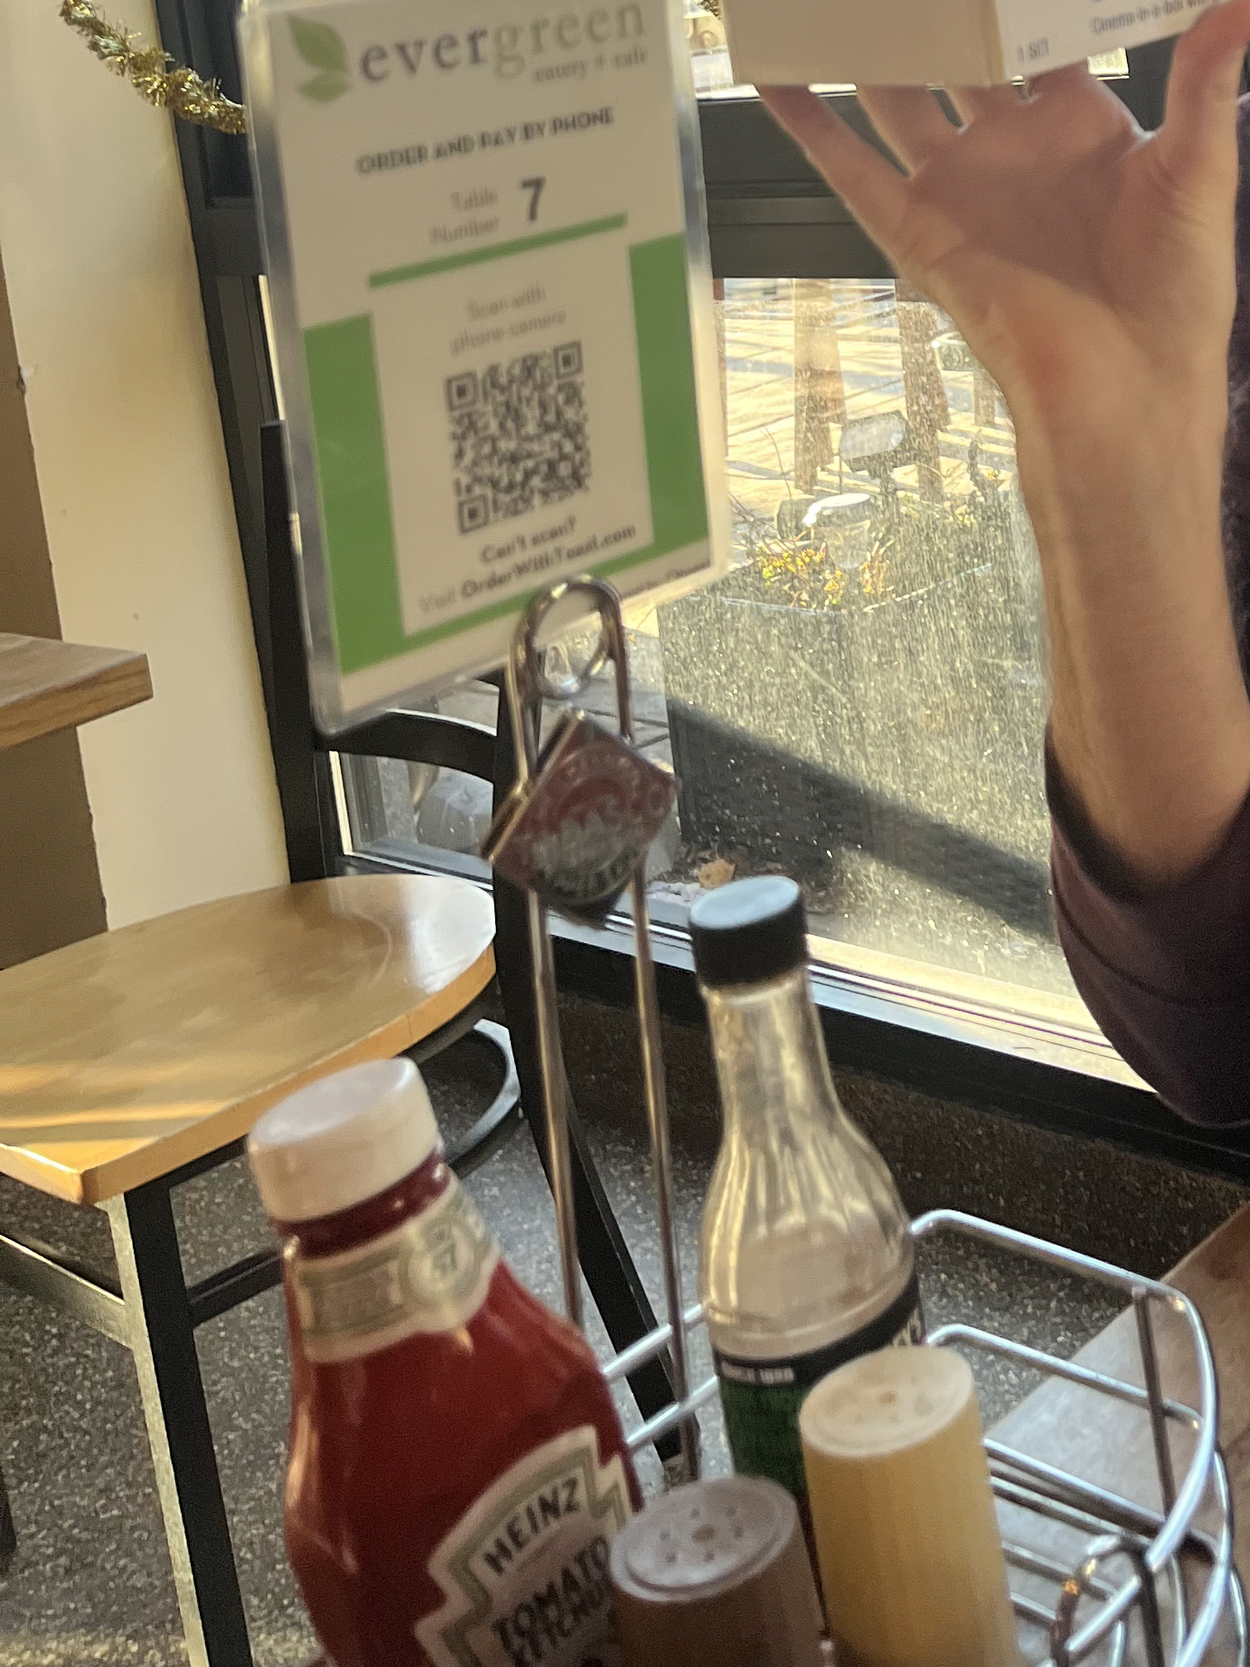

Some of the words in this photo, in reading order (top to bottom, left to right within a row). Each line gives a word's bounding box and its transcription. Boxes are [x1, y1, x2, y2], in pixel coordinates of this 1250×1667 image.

[359, 1, 646, 83] evergreen
[356, 145, 428, 174] ORDER
[435, 134, 475, 158] AND
[479, 127, 516, 149] PAY
[520, 120, 546, 140] BY
[551, 106, 614, 135] PHONE
[430, 217, 498, 245] Number
[452, 187, 498, 211] Table
[520, 176, 546, 221] 7
[481, 534, 527, 563] Can't
[482, 1476, 580, 1576] HEINZ
[491, 1537, 609, 1662] TOMATO
